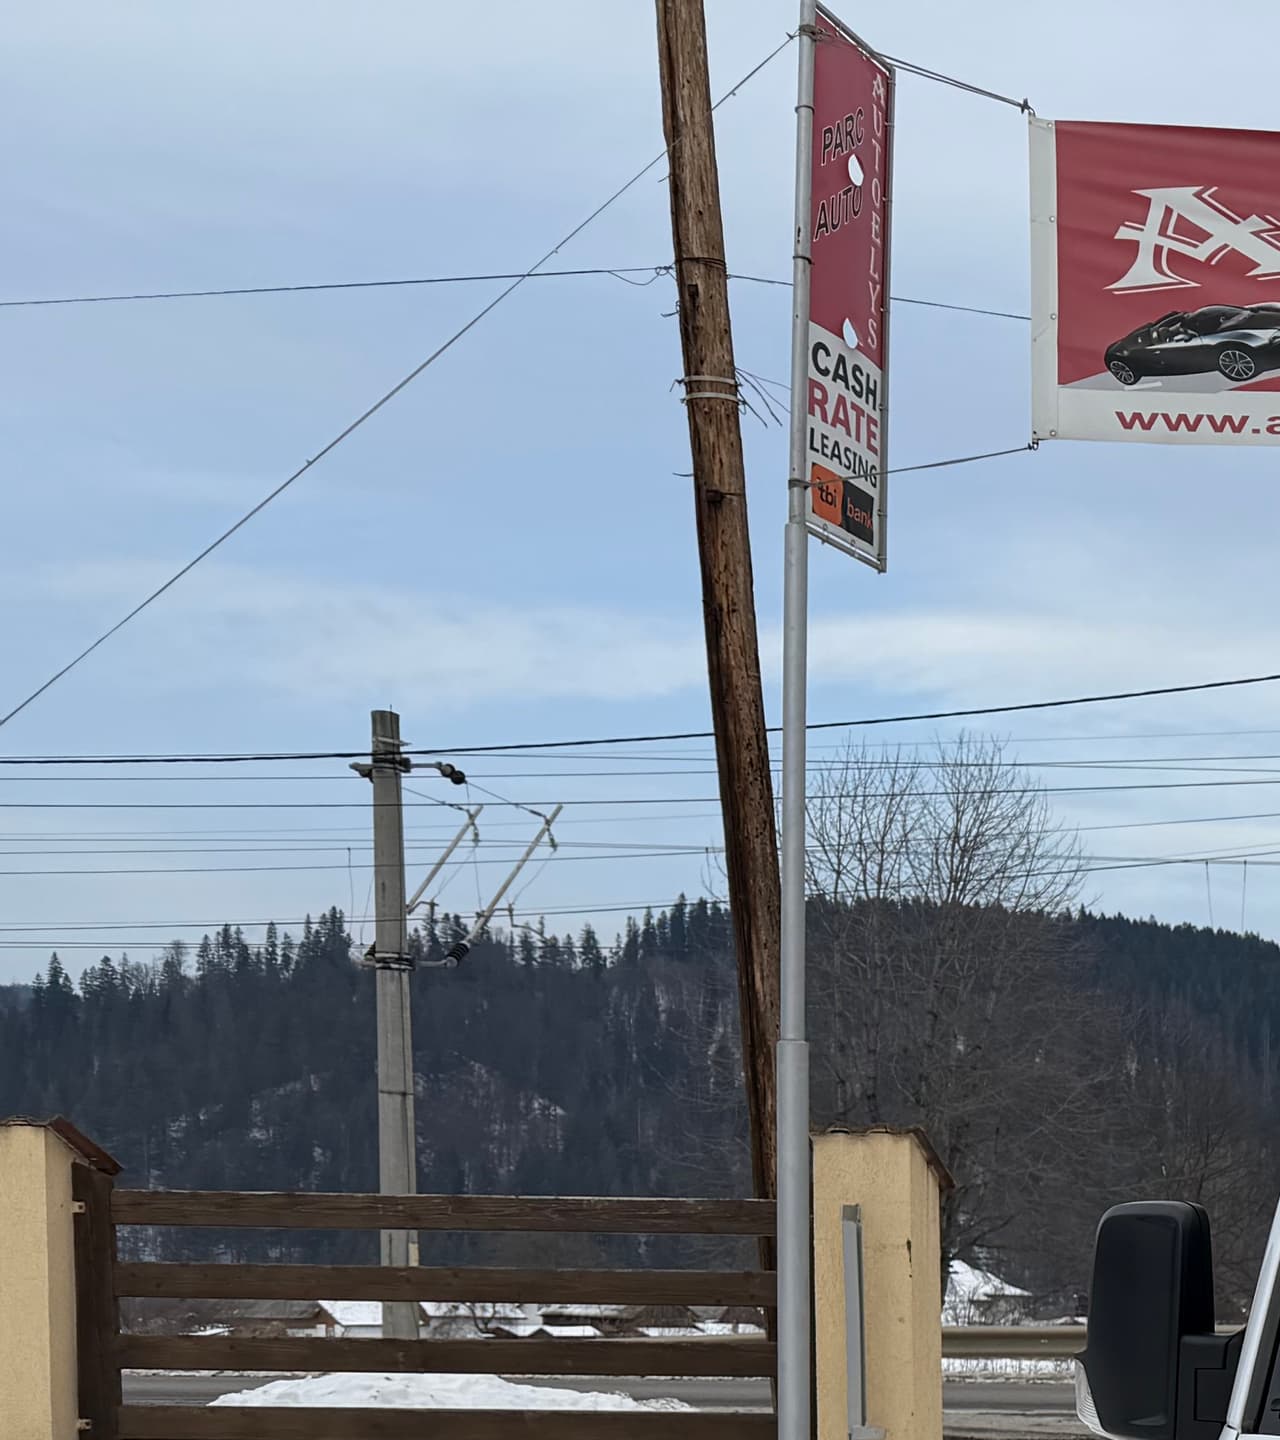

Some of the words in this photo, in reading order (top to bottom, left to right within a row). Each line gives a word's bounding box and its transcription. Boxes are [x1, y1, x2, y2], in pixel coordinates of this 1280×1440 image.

[820, 106, 865, 166] PARC
[813, 184, 864, 242] AUTO
[811, 341, 878, 412] CASH
[807, 376, 879, 456] RATE
[810, 427, 878, 489] LEASING
[817, 484, 837, 509] tbi
[847, 496, 873, 529] bank
